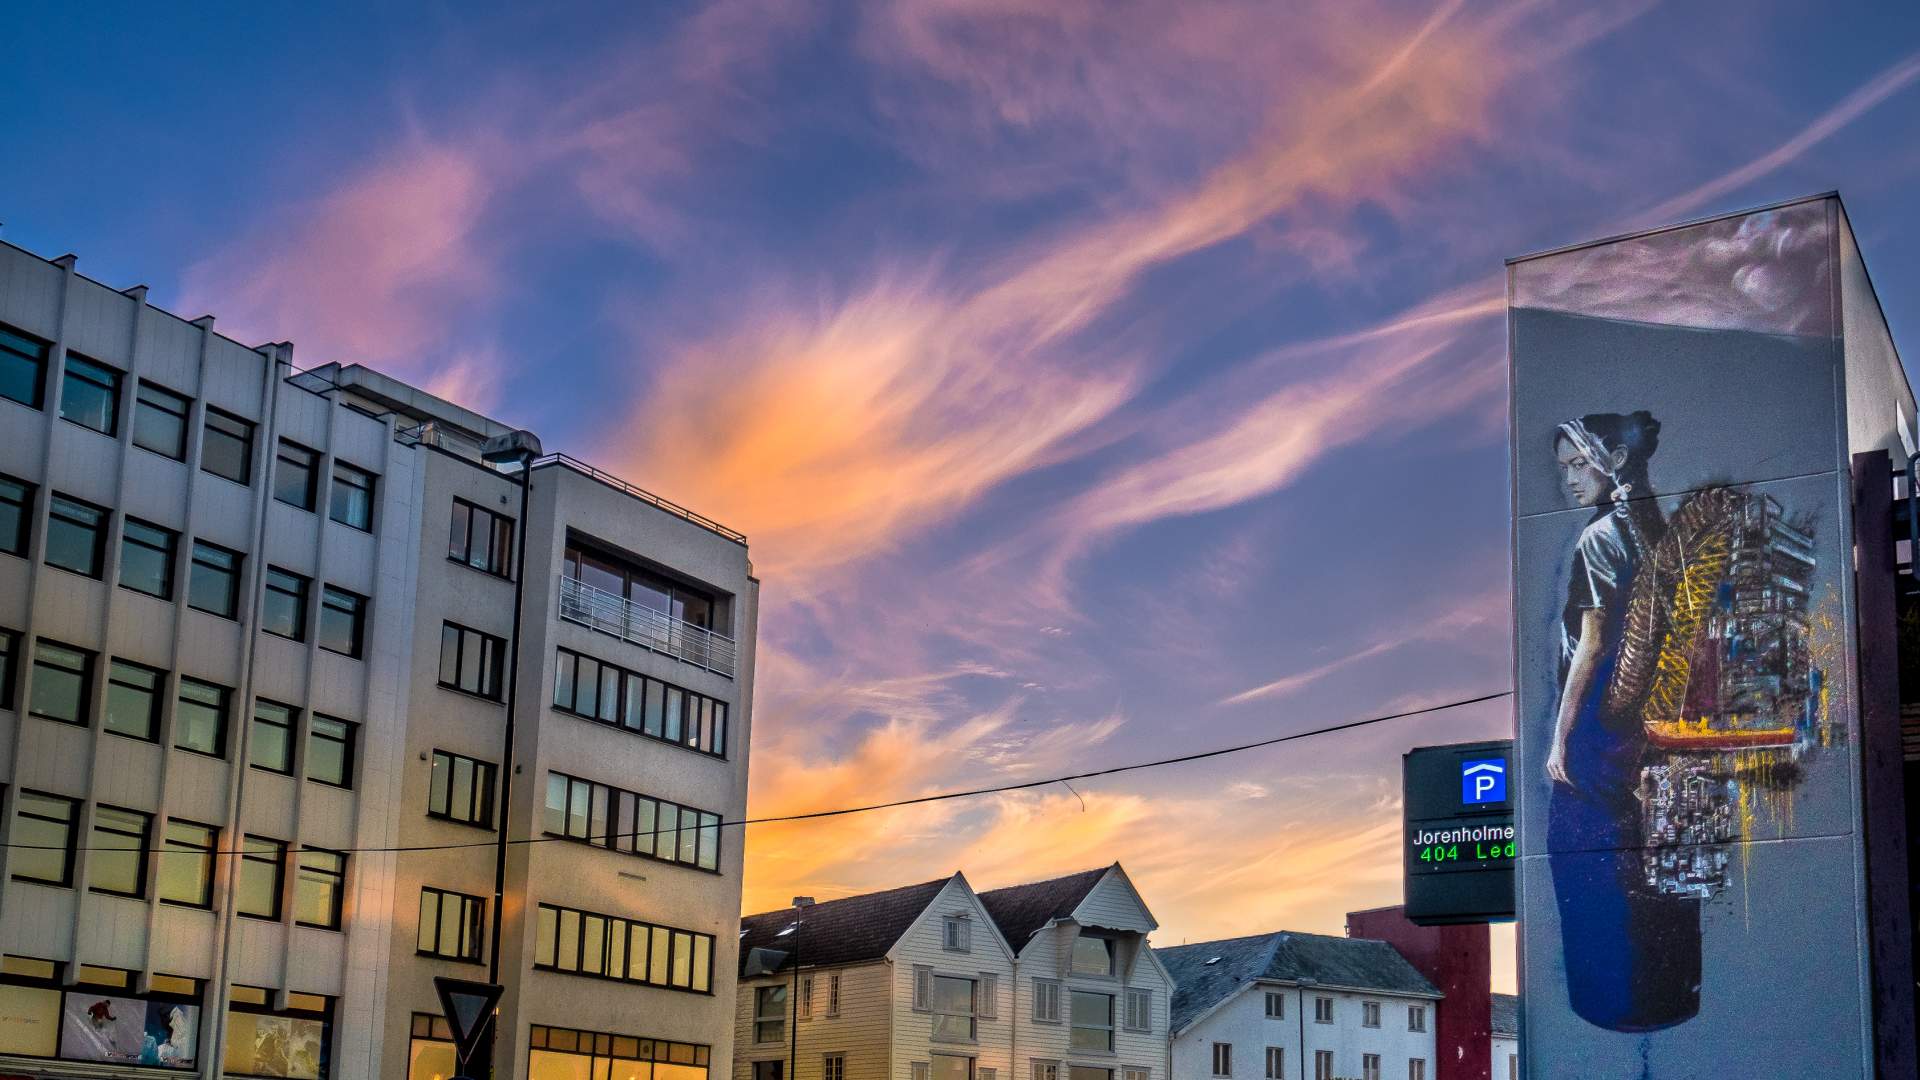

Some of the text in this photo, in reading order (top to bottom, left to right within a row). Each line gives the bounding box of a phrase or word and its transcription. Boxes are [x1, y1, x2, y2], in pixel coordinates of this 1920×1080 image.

[1476, 776, 1495, 800] P
[1413, 825, 1514, 845] Jorenholme
[1420, 842, 1515, 862] 404 Led
